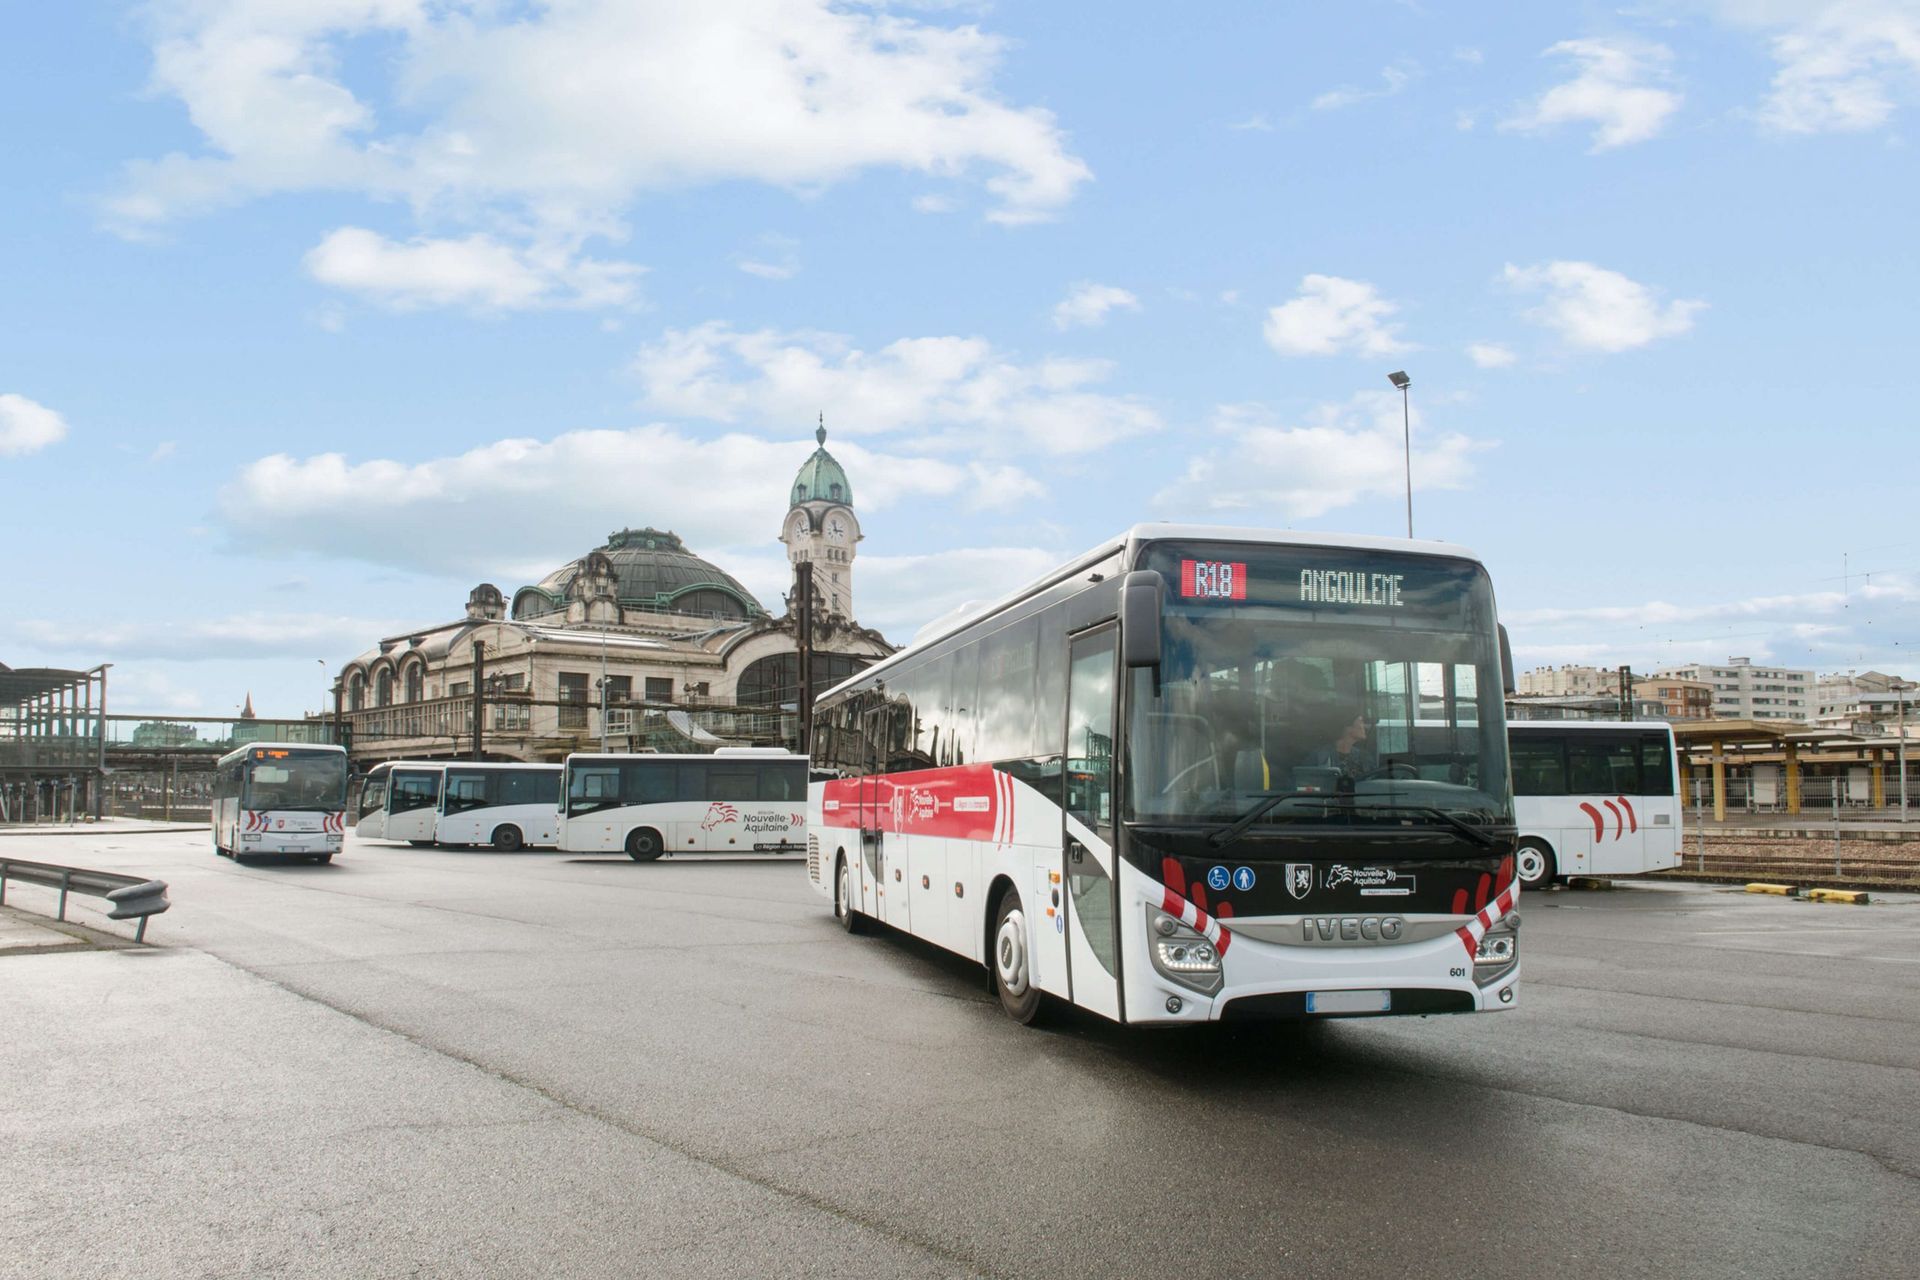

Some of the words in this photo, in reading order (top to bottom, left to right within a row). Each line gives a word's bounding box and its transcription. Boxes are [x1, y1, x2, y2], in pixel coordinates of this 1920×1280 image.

[1195, 562, 1233, 596] R18
[1300, 569, 1404, 606] ANGOULEME
[743, 814, 789, 823] Nouvelle-
[743, 823, 789, 834] Aquitaine
[1353, 869, 1387, 877] Nouvelle-
[1353, 877, 1386, 886] Aquitaine
[1303, 917, 1402, 941] IVECO
[1450, 968, 1465, 977] 601
